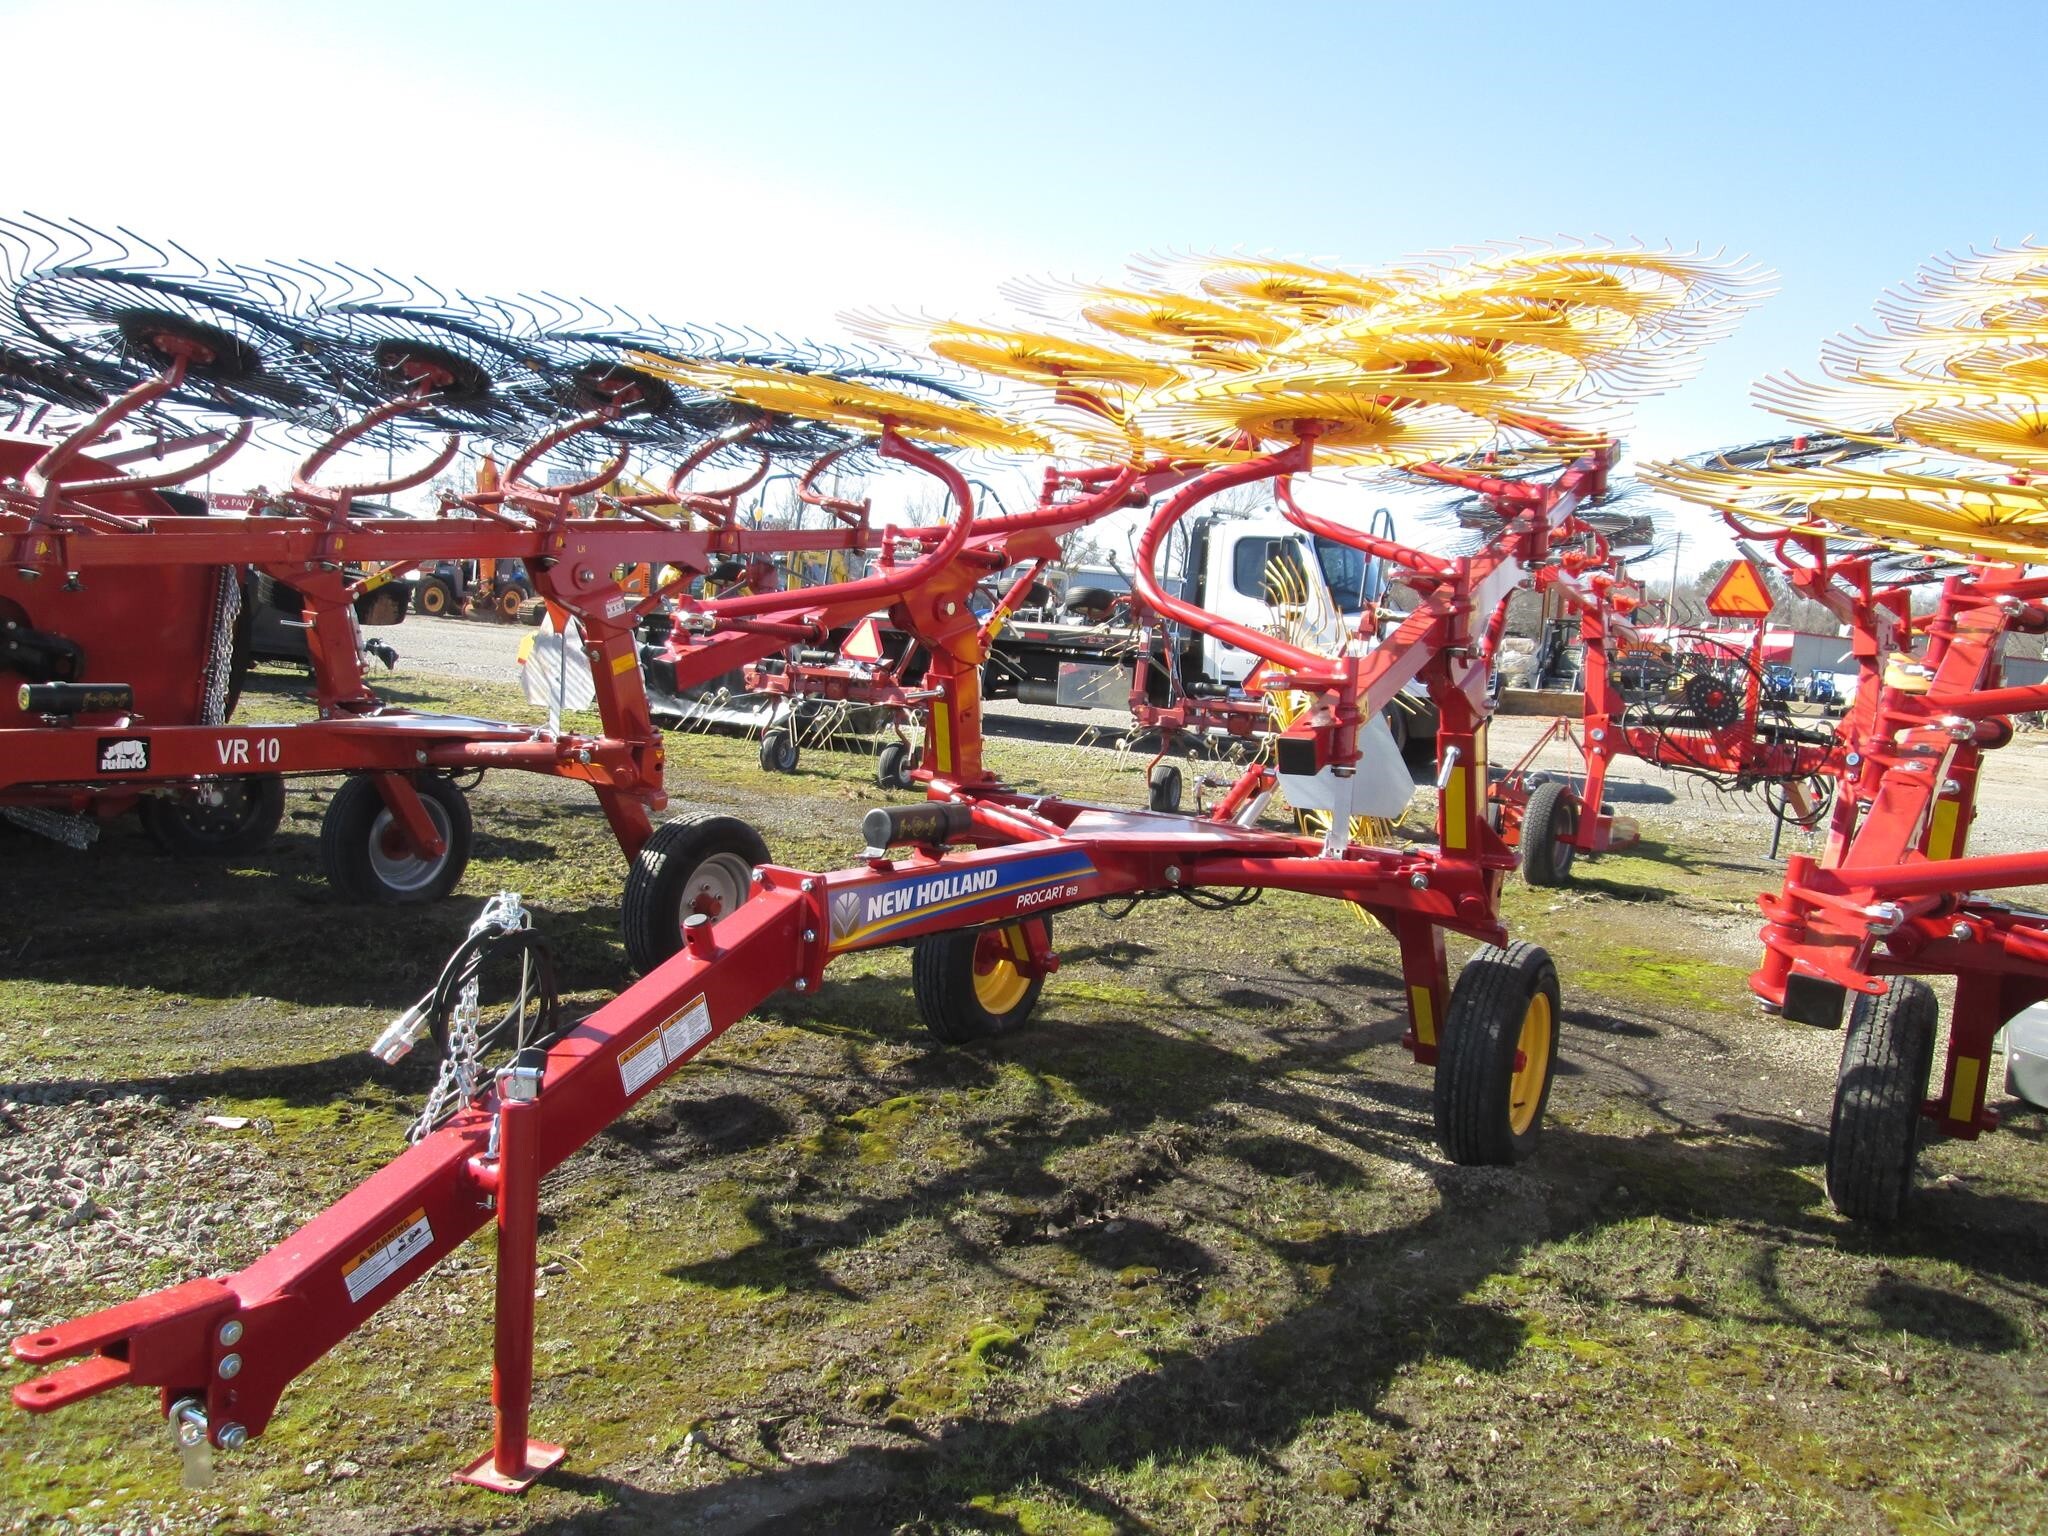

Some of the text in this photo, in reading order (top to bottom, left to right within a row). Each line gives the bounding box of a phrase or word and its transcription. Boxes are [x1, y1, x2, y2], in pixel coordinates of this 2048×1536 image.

[101, 757, 147, 770] RHINO
[217, 737, 280, 765] VR 10
[867, 869, 998, 922] NEW HOLLAND
[1016, 885, 1079, 909] PROCART 819
[367, 1219, 410, 1256] WARNING
